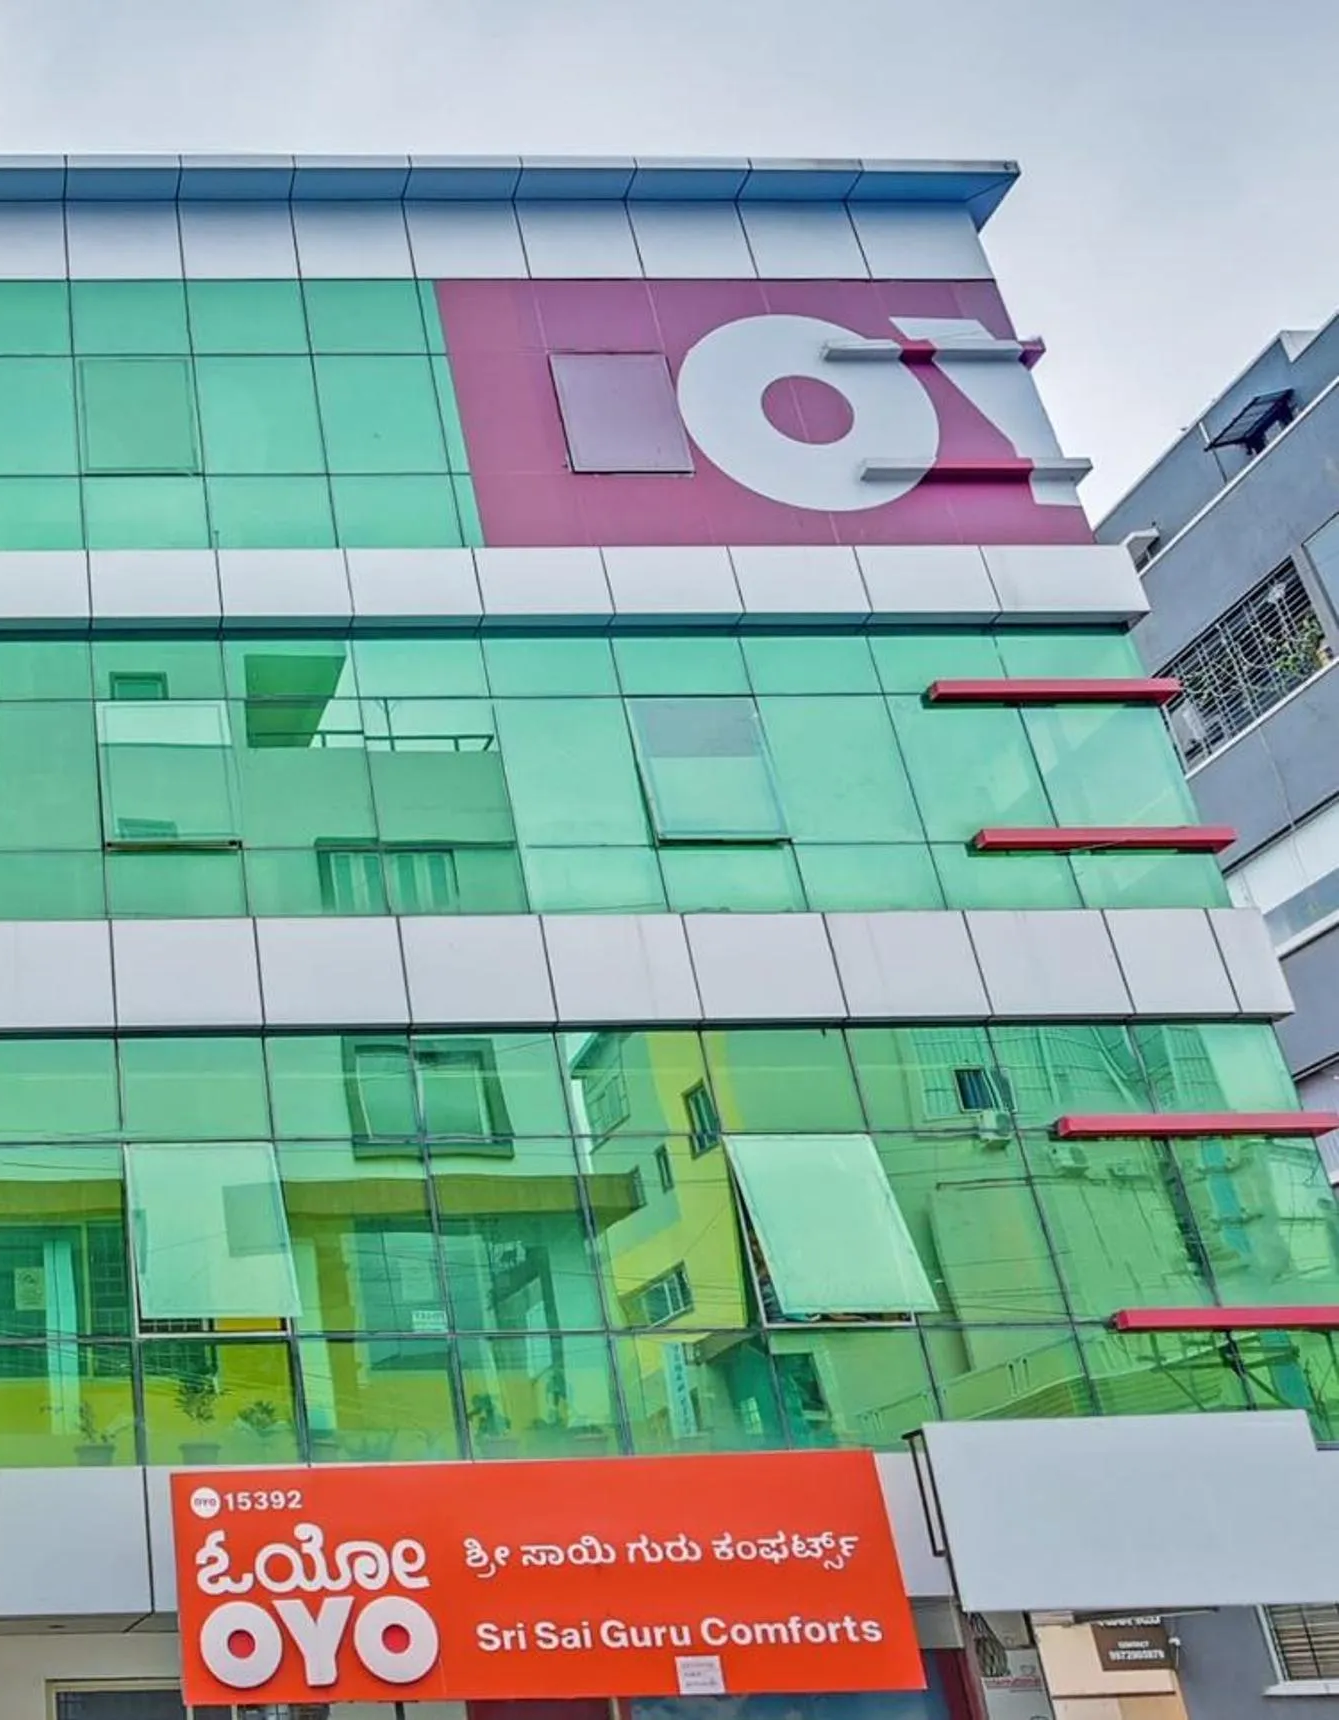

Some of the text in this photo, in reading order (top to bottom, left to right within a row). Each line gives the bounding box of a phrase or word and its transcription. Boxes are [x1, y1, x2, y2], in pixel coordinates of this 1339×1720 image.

[223, 1489, 303, 1511] 15392
[195, 1523, 431, 1594] ಓಯೋ
[463, 1537, 511, 1578] ಶ್ರೀ
[520, 1535, 617, 1567] ಸಾಯಿ
[626, 1533, 702, 1563] ಗುರು
[200, 1595, 440, 1689] OYO
[476, 1615, 883, 1651] Sri Sai Guru Comforts
